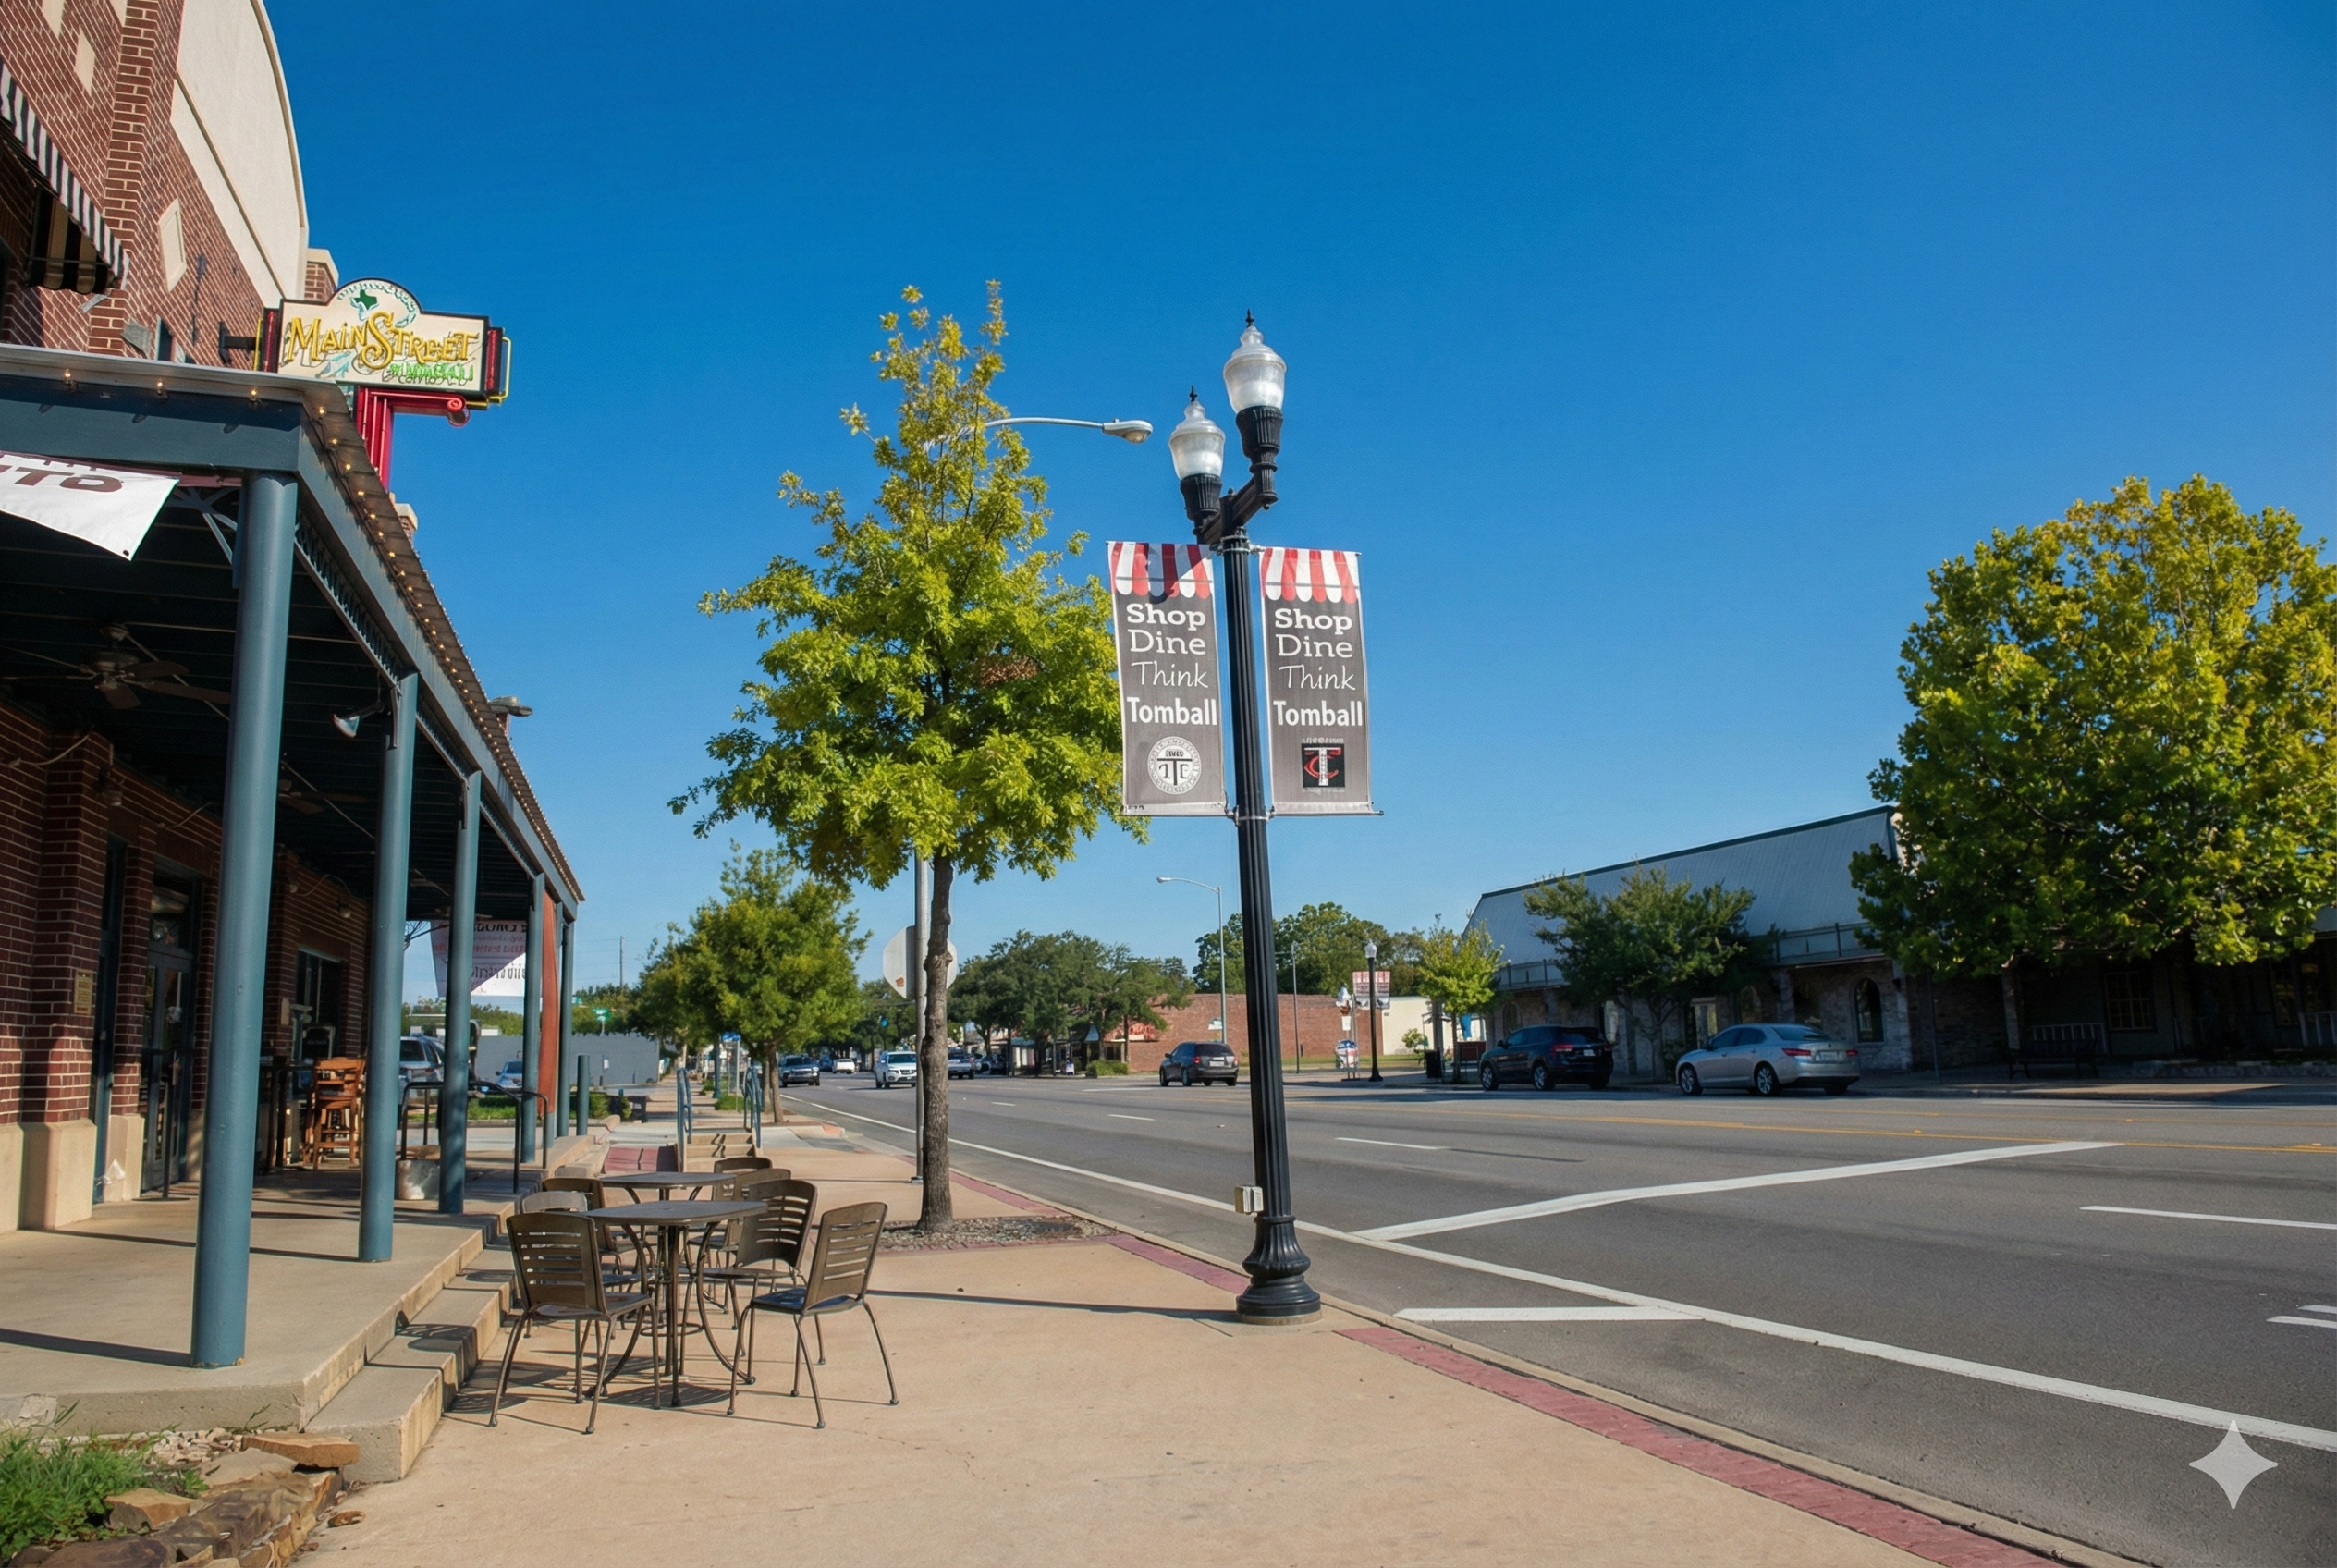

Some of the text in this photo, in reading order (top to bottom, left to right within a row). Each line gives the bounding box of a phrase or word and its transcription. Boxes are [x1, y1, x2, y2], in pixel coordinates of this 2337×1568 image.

[1126, 603, 1206, 631] Shop
[1275, 608, 1352, 635] Shop
[1127, 629, 1206, 655] Dine
[1275, 634, 1352, 658] Dine
[1131, 660, 1208, 688] Think
[1279, 664, 1356, 690] Think
[1126, 696, 1217, 725] Tomball
[1273, 700, 1363, 726] Tomball
